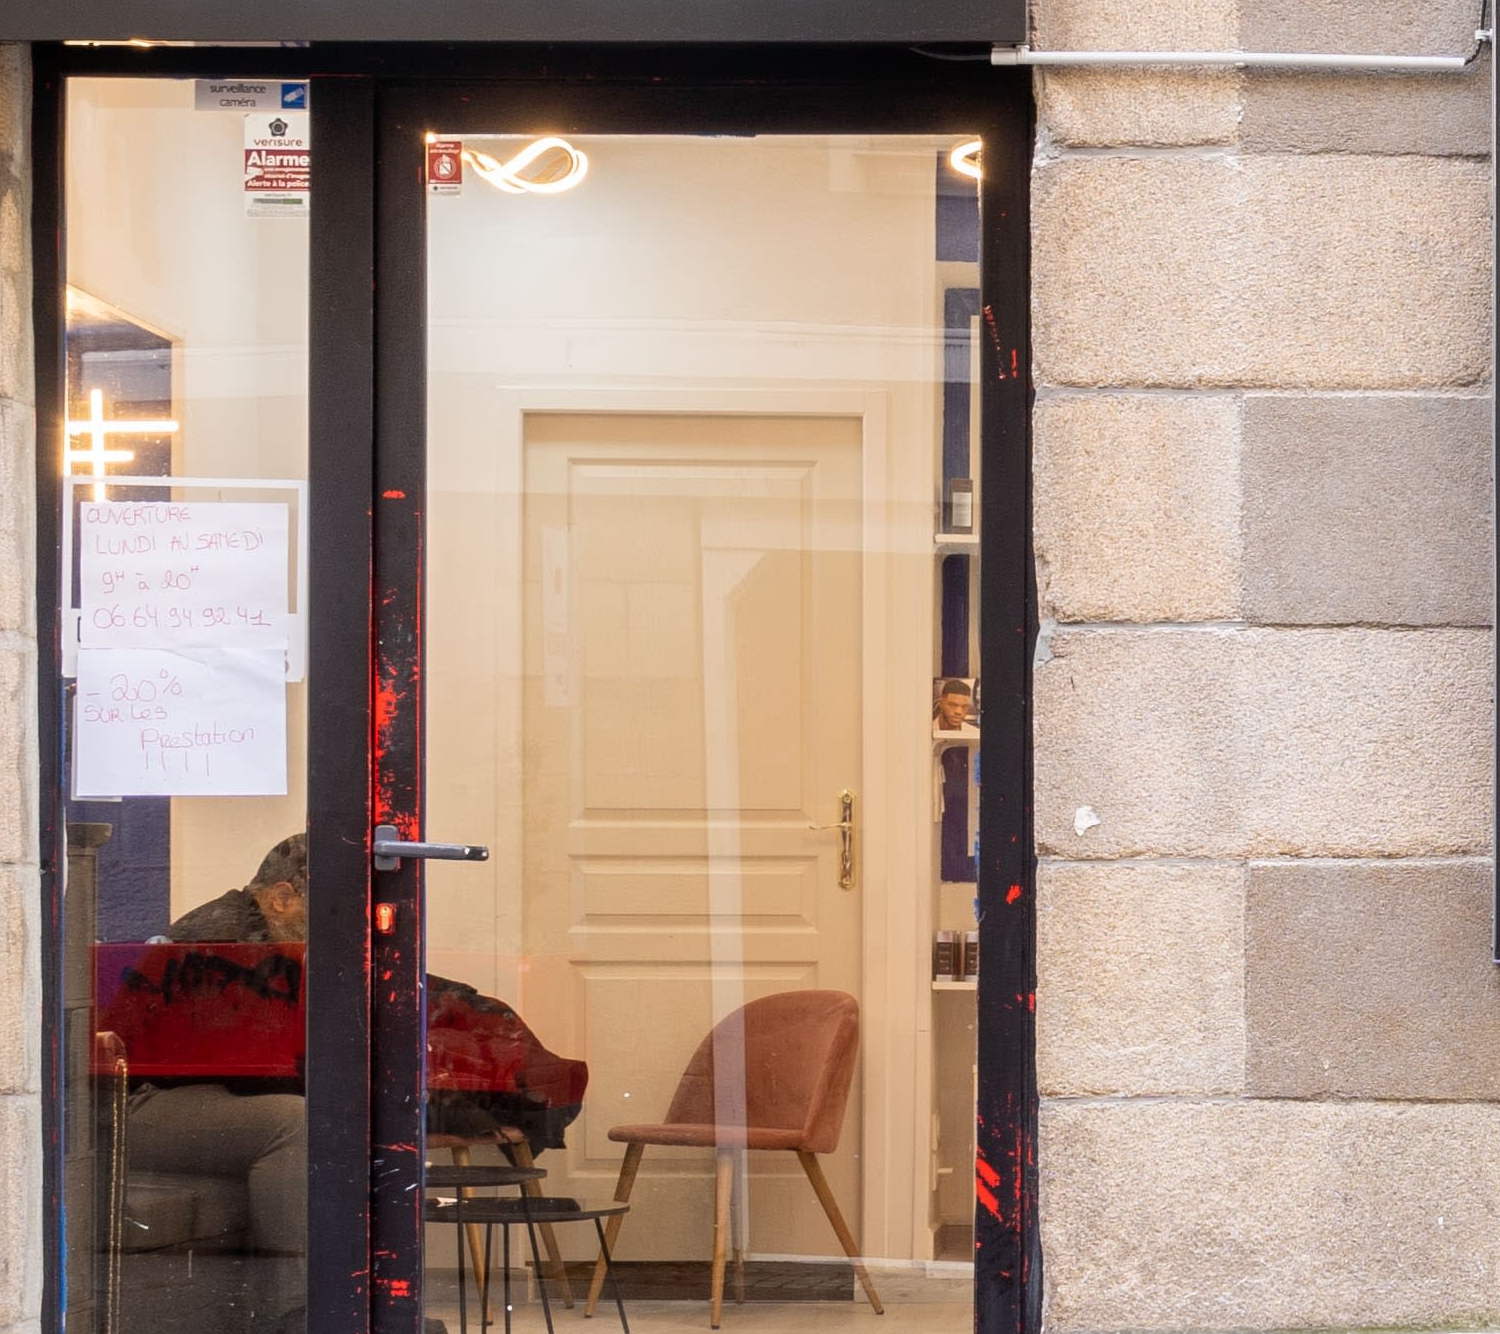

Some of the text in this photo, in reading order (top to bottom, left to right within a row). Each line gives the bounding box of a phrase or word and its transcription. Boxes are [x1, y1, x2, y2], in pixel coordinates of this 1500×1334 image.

[209, 84, 267, 95] surveillance
[219, 97, 257, 108] caméra
[253, 138, 303, 147] verisure
[247, 151, 310, 166] Alarme
[87, 505, 191, 526] OUVERTURE
[96, 534, 156, 555] LUNDI
[196, 530, 265, 551] SAMEDI
